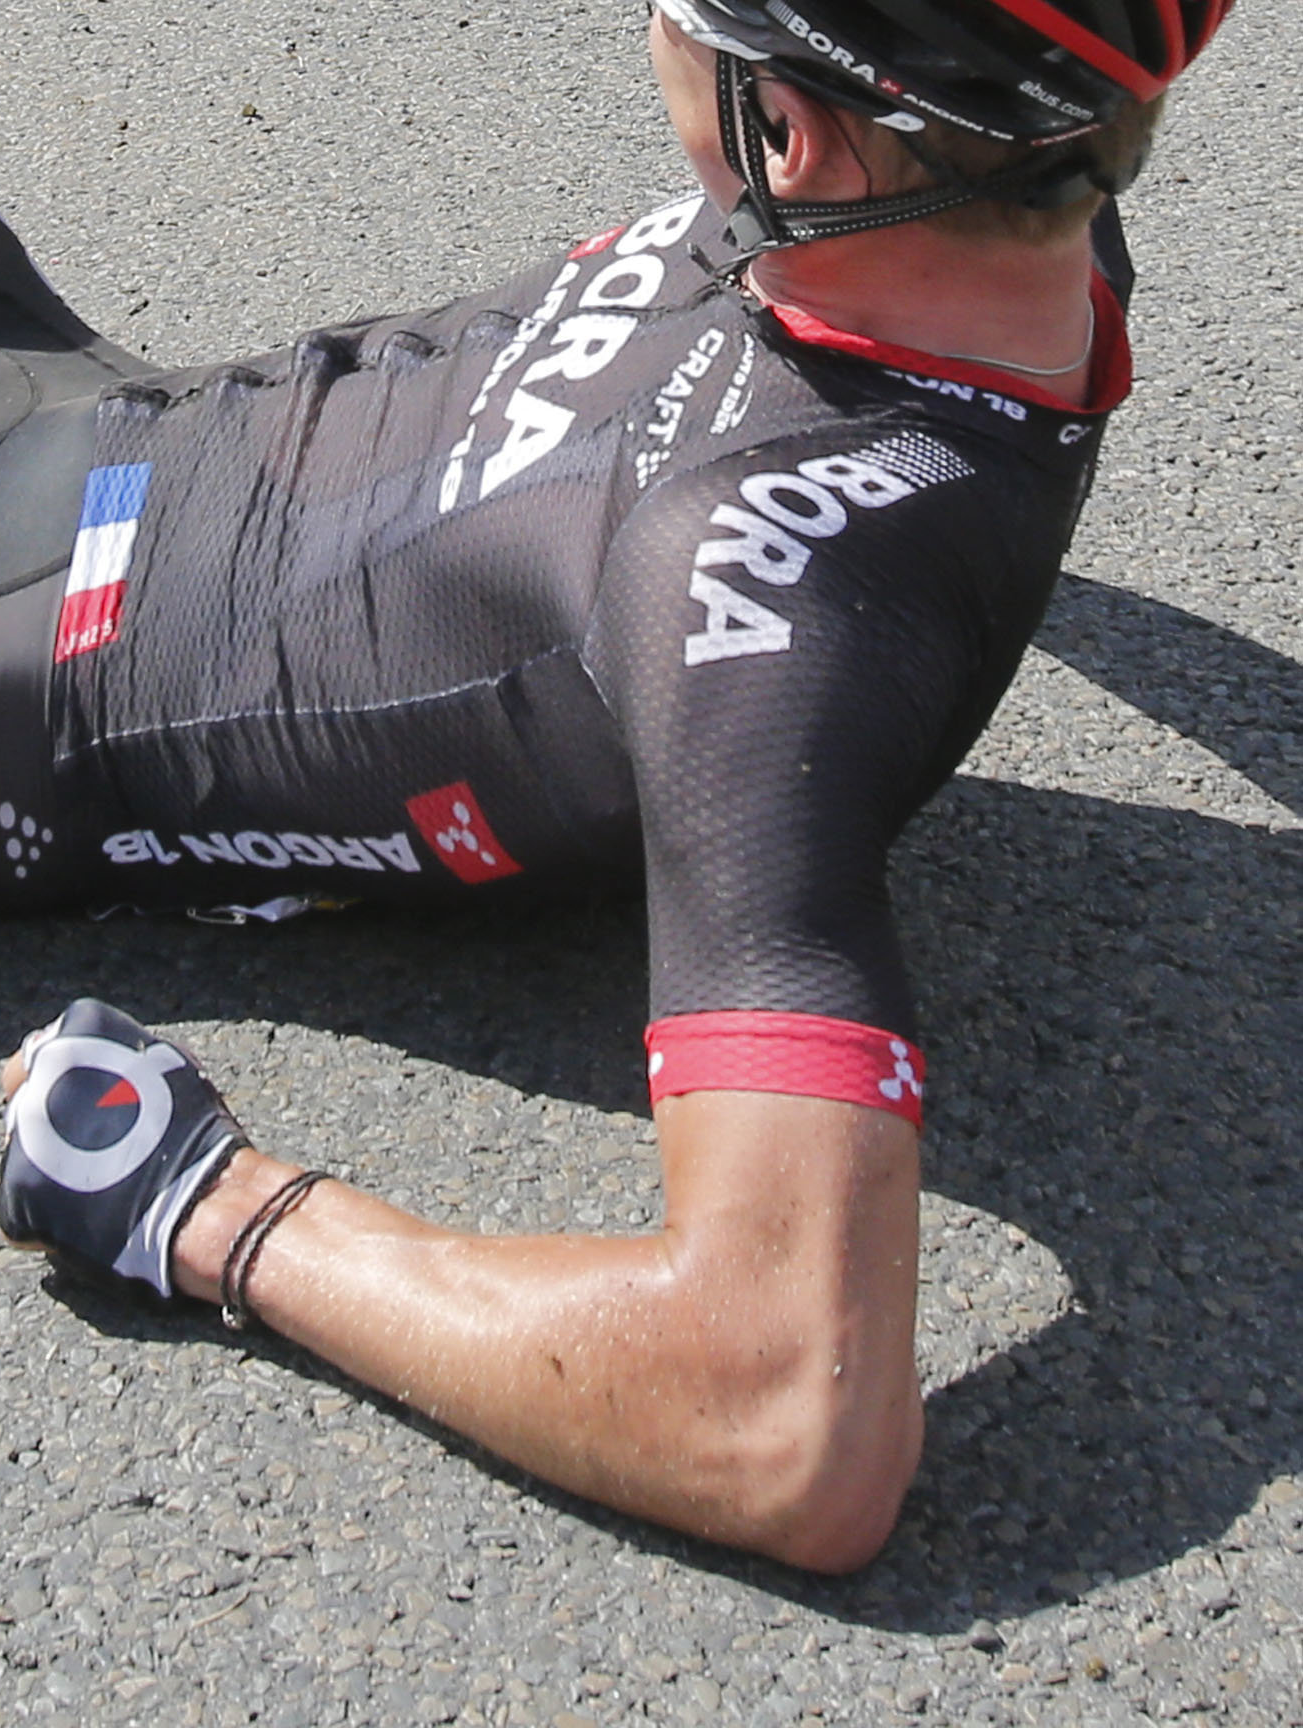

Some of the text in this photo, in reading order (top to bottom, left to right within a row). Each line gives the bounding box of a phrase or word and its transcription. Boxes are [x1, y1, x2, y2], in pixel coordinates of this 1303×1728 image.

[787, 14, 877, 84] BORA
[902, 93, 984, 132] ARGON
[1018, 80, 1095, 122] abus.com
[479, 196, 705, 500] BORA
[647, 328, 725, 445] CRAFT
[683, 454, 910, 668] BORA
[102, 829, 422, 873] ARGON 18
